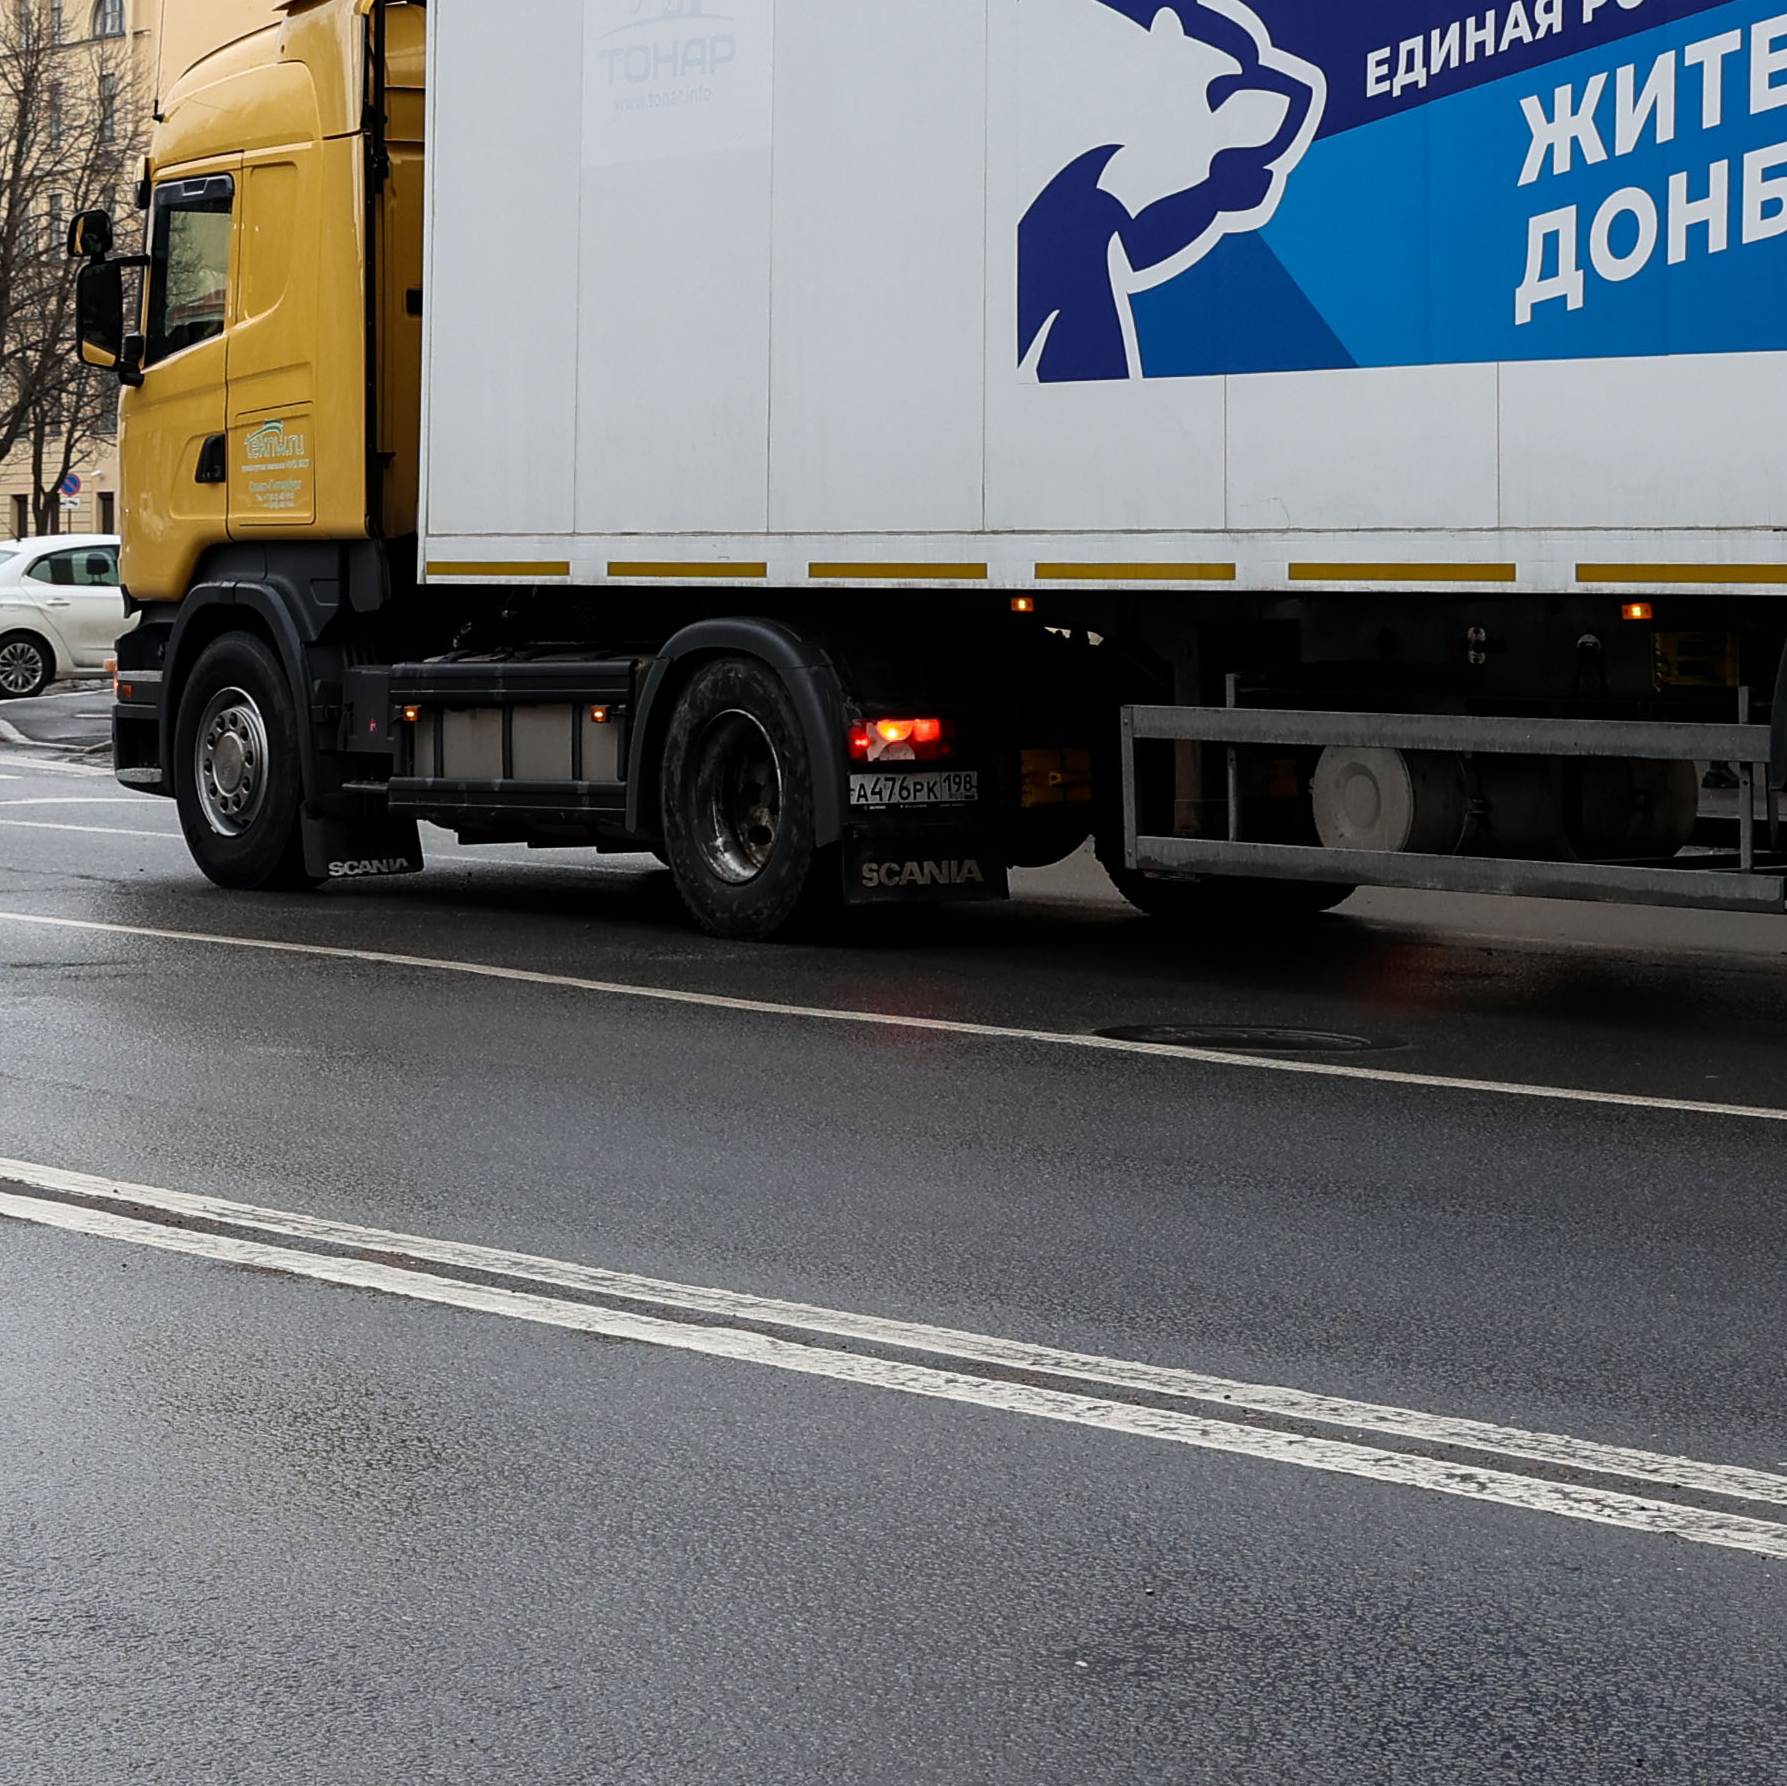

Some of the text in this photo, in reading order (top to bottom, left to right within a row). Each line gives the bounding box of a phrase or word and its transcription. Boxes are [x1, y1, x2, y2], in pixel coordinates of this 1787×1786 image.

[599, 35, 735, 86] ТОНАР
[856, 773, 972, 802] А476РК 198
[328, 858, 408, 876] SCANIA
[862, 859, 984, 887] SCANIA
